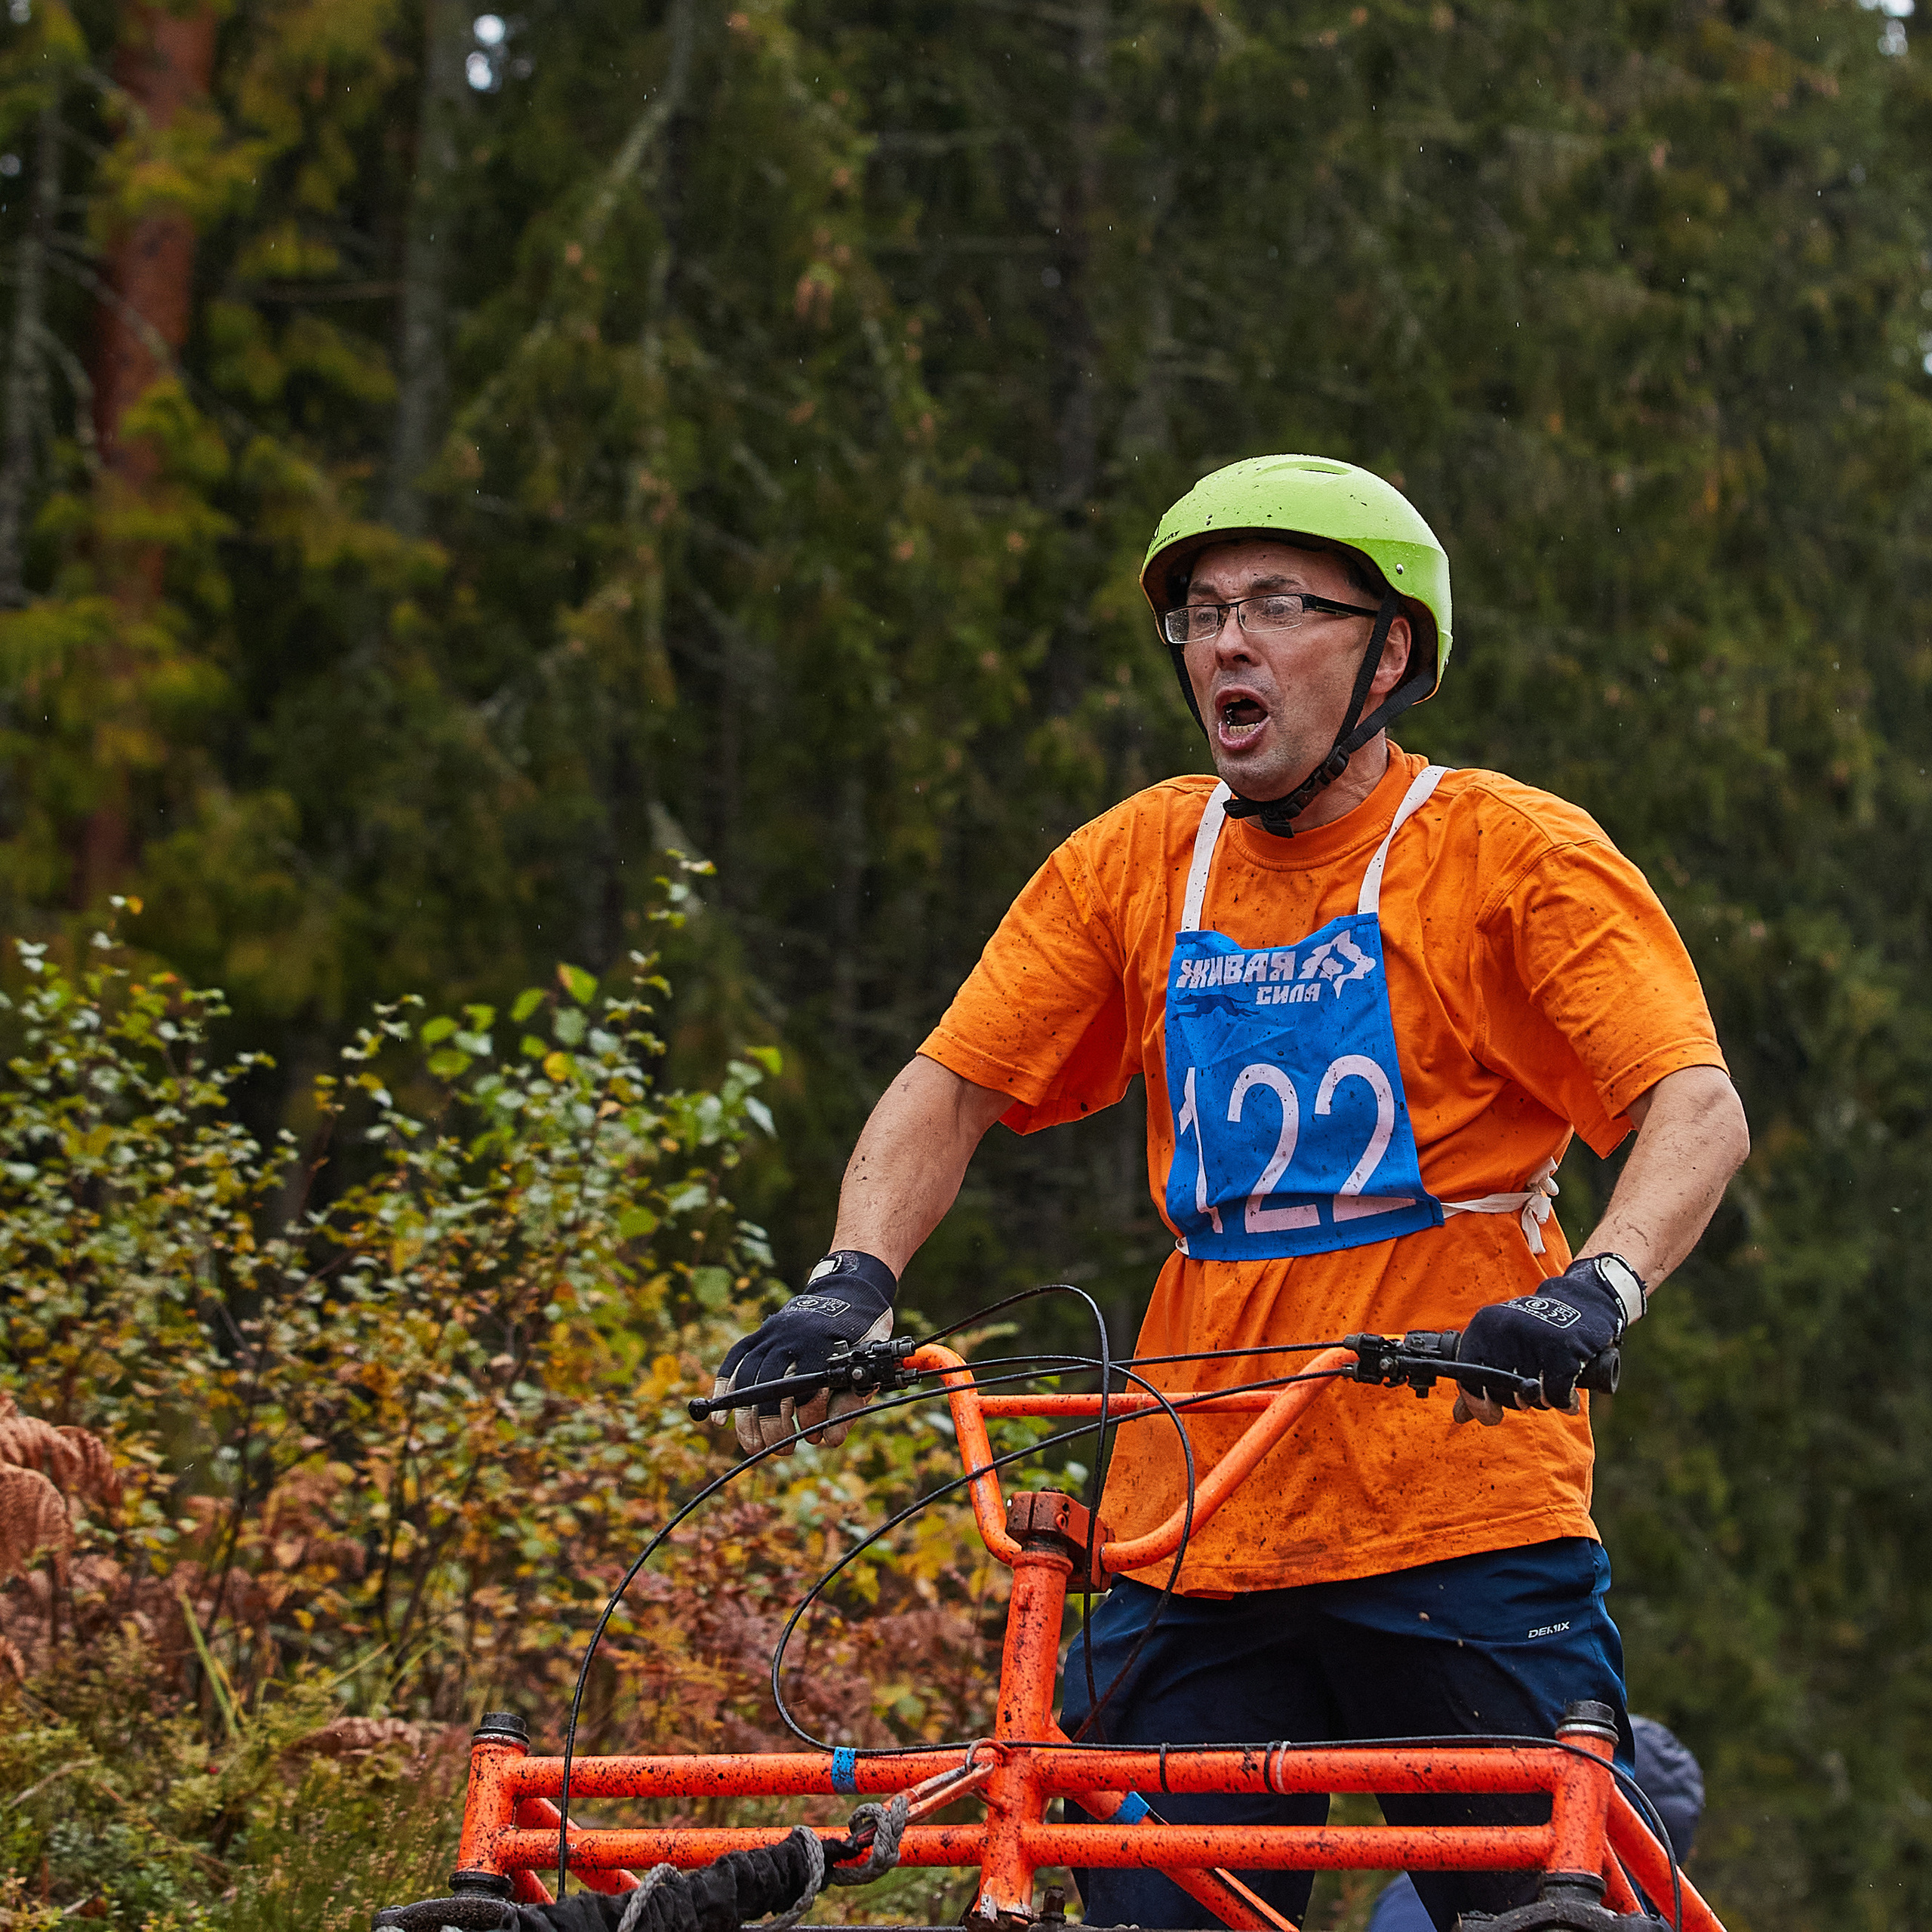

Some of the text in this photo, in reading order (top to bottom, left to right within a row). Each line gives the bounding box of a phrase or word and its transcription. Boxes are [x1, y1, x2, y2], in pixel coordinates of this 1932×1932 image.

[1176, 951, 1296, 989] ЖИВАЯ
[1256, 983, 1321, 1004] СИЛА
[1178, 1054, 1417, 1233] 122
[1527, 1621, 1570, 1638] DEMIX
